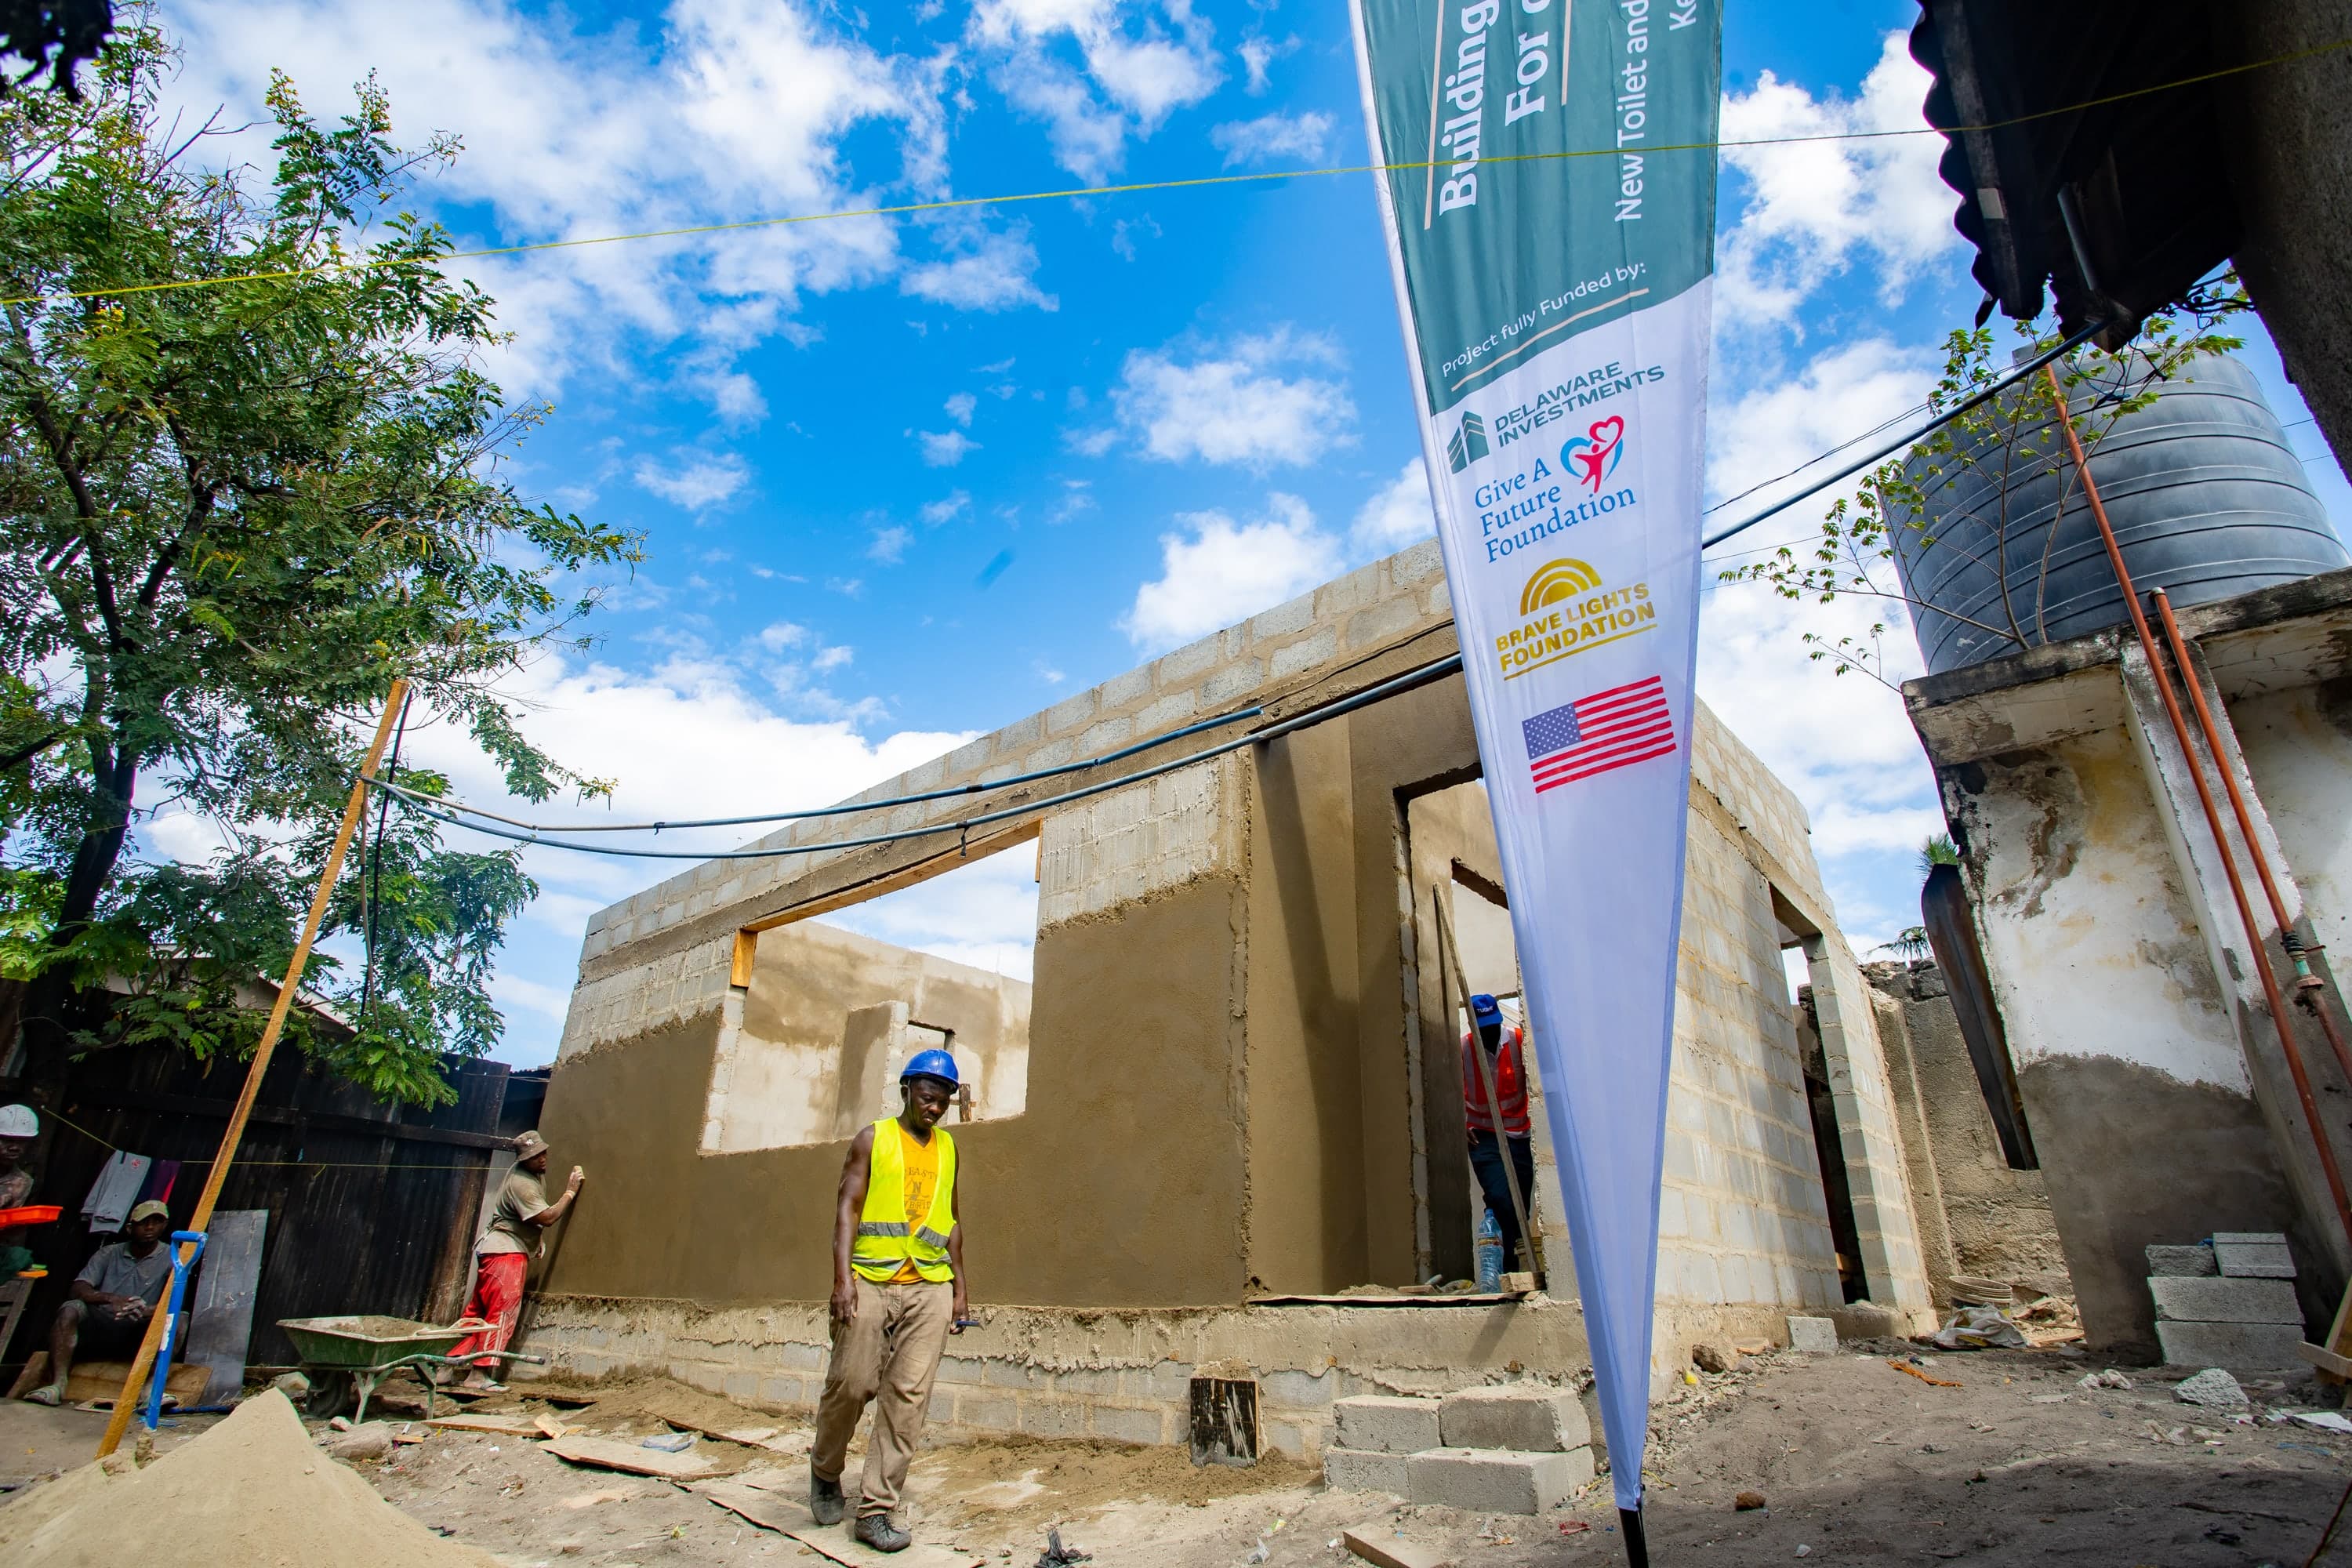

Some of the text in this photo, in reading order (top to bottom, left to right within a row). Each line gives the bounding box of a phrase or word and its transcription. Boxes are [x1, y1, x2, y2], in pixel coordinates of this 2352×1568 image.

[1439, 0, 1500, 216] Building
[1505, 31, 1548, 126] For
[1614, 0, 1649, 223] New Toilet and
[1442, 261, 1646, 377] Project fully Funded by:
[1494, 361, 1623, 430] DELAWARE
[1498, 365, 1665, 448] INVESTMENTS
[1475, 457, 1552, 509] Give A
[1479, 485, 1562, 537] Future
[1486, 488, 1637, 563] Foundation
[1496, 583, 1650, 652] BRAVE LIGHTS
[1500, 601, 1656, 672] FOUNDATION
